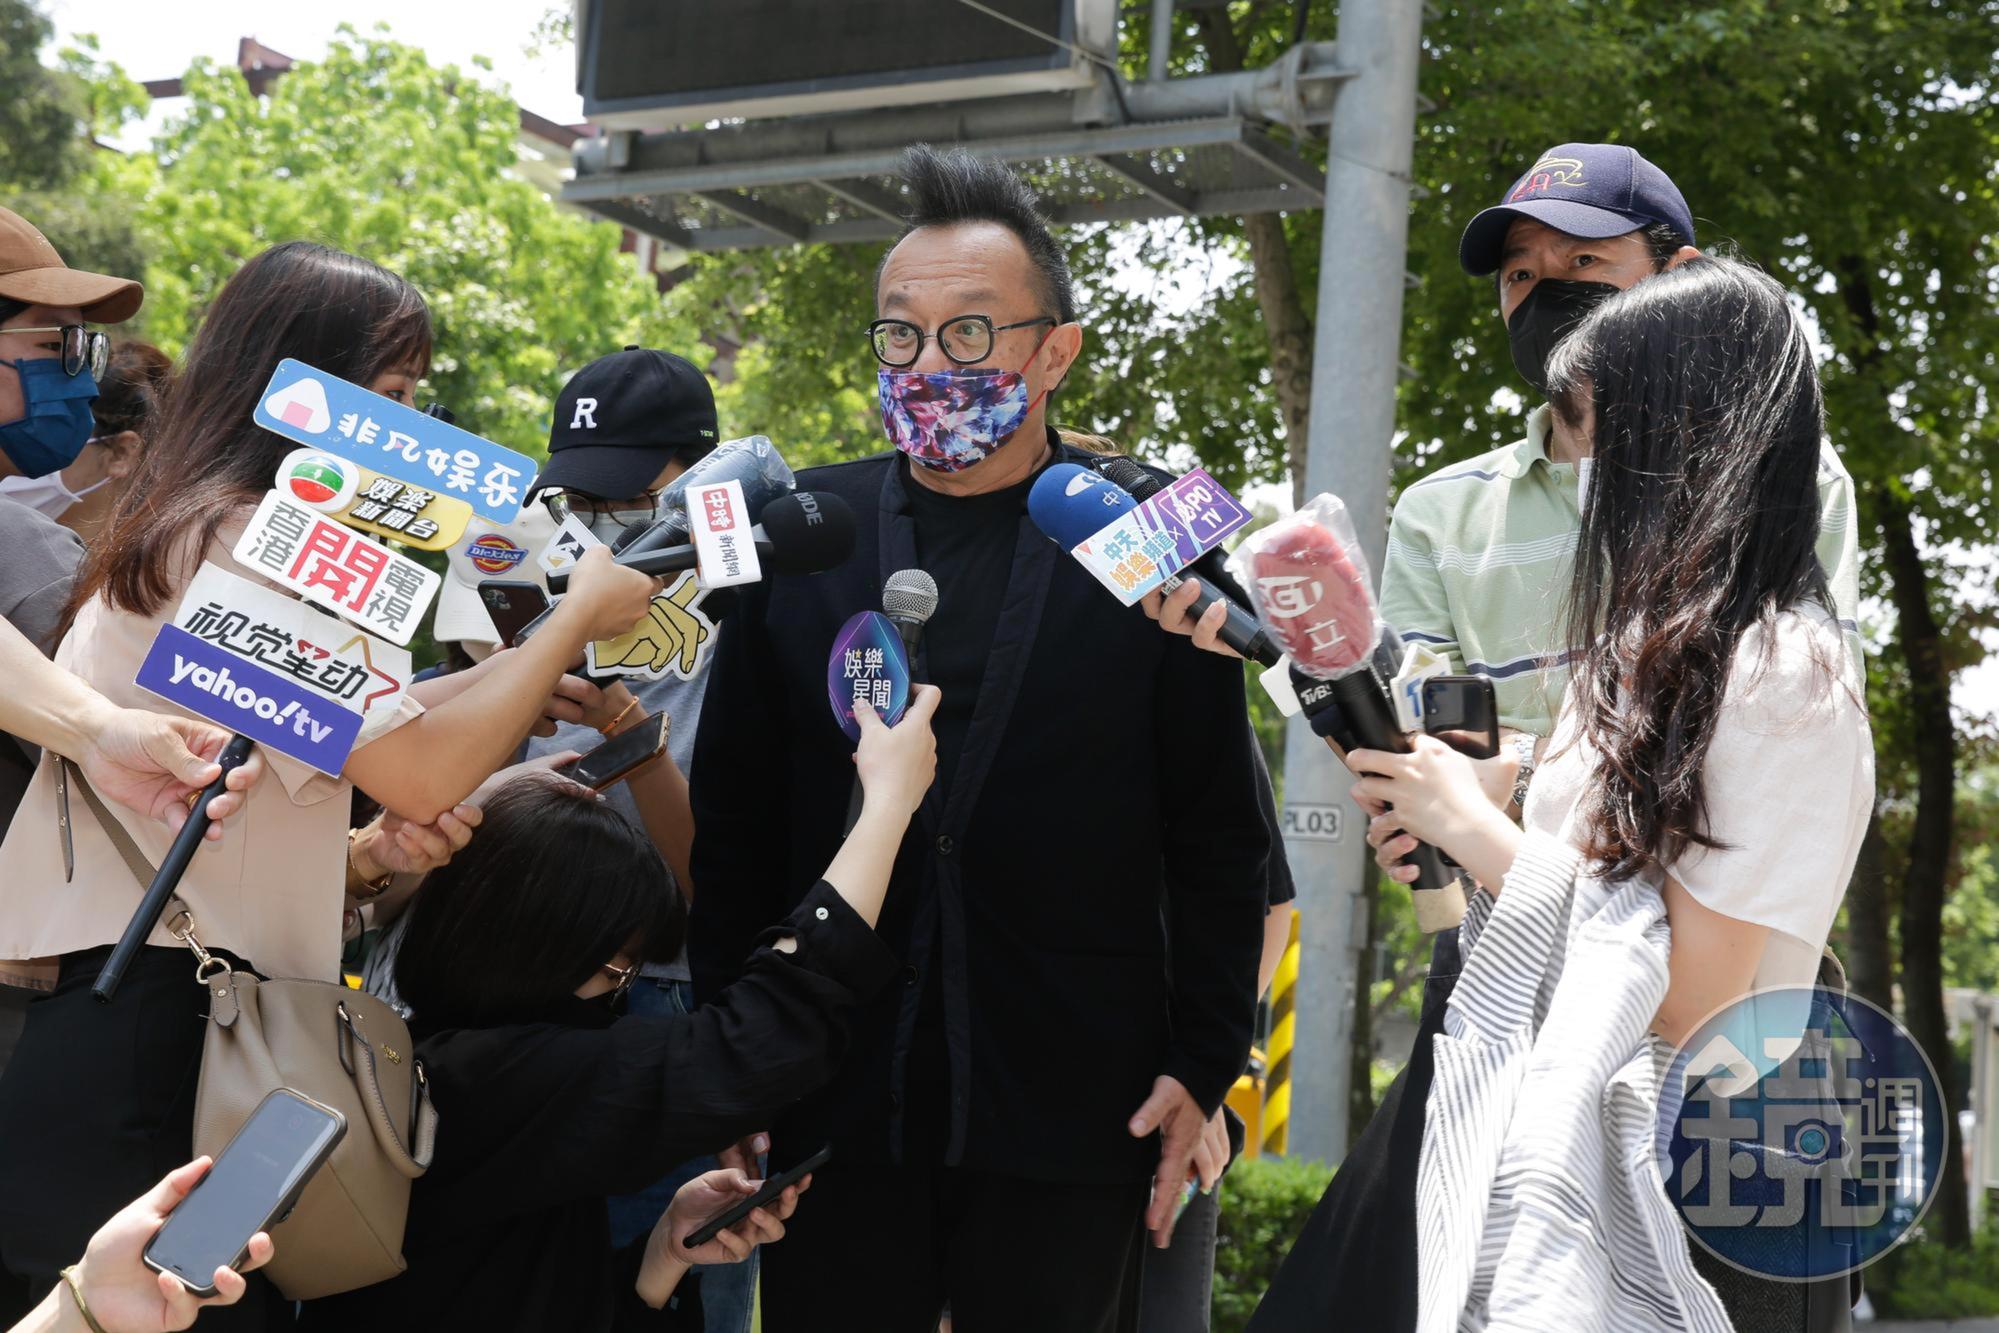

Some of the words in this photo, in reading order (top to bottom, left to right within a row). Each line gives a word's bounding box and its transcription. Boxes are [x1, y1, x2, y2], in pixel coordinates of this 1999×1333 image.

[570, 397, 598, 429] R
[337, 413, 521, 508] 非凡娱乐
[1201, 507, 1223, 529] TV
[1103, 529, 1139, 562] 中天
[844, 647, 884, 678] 娛樂
